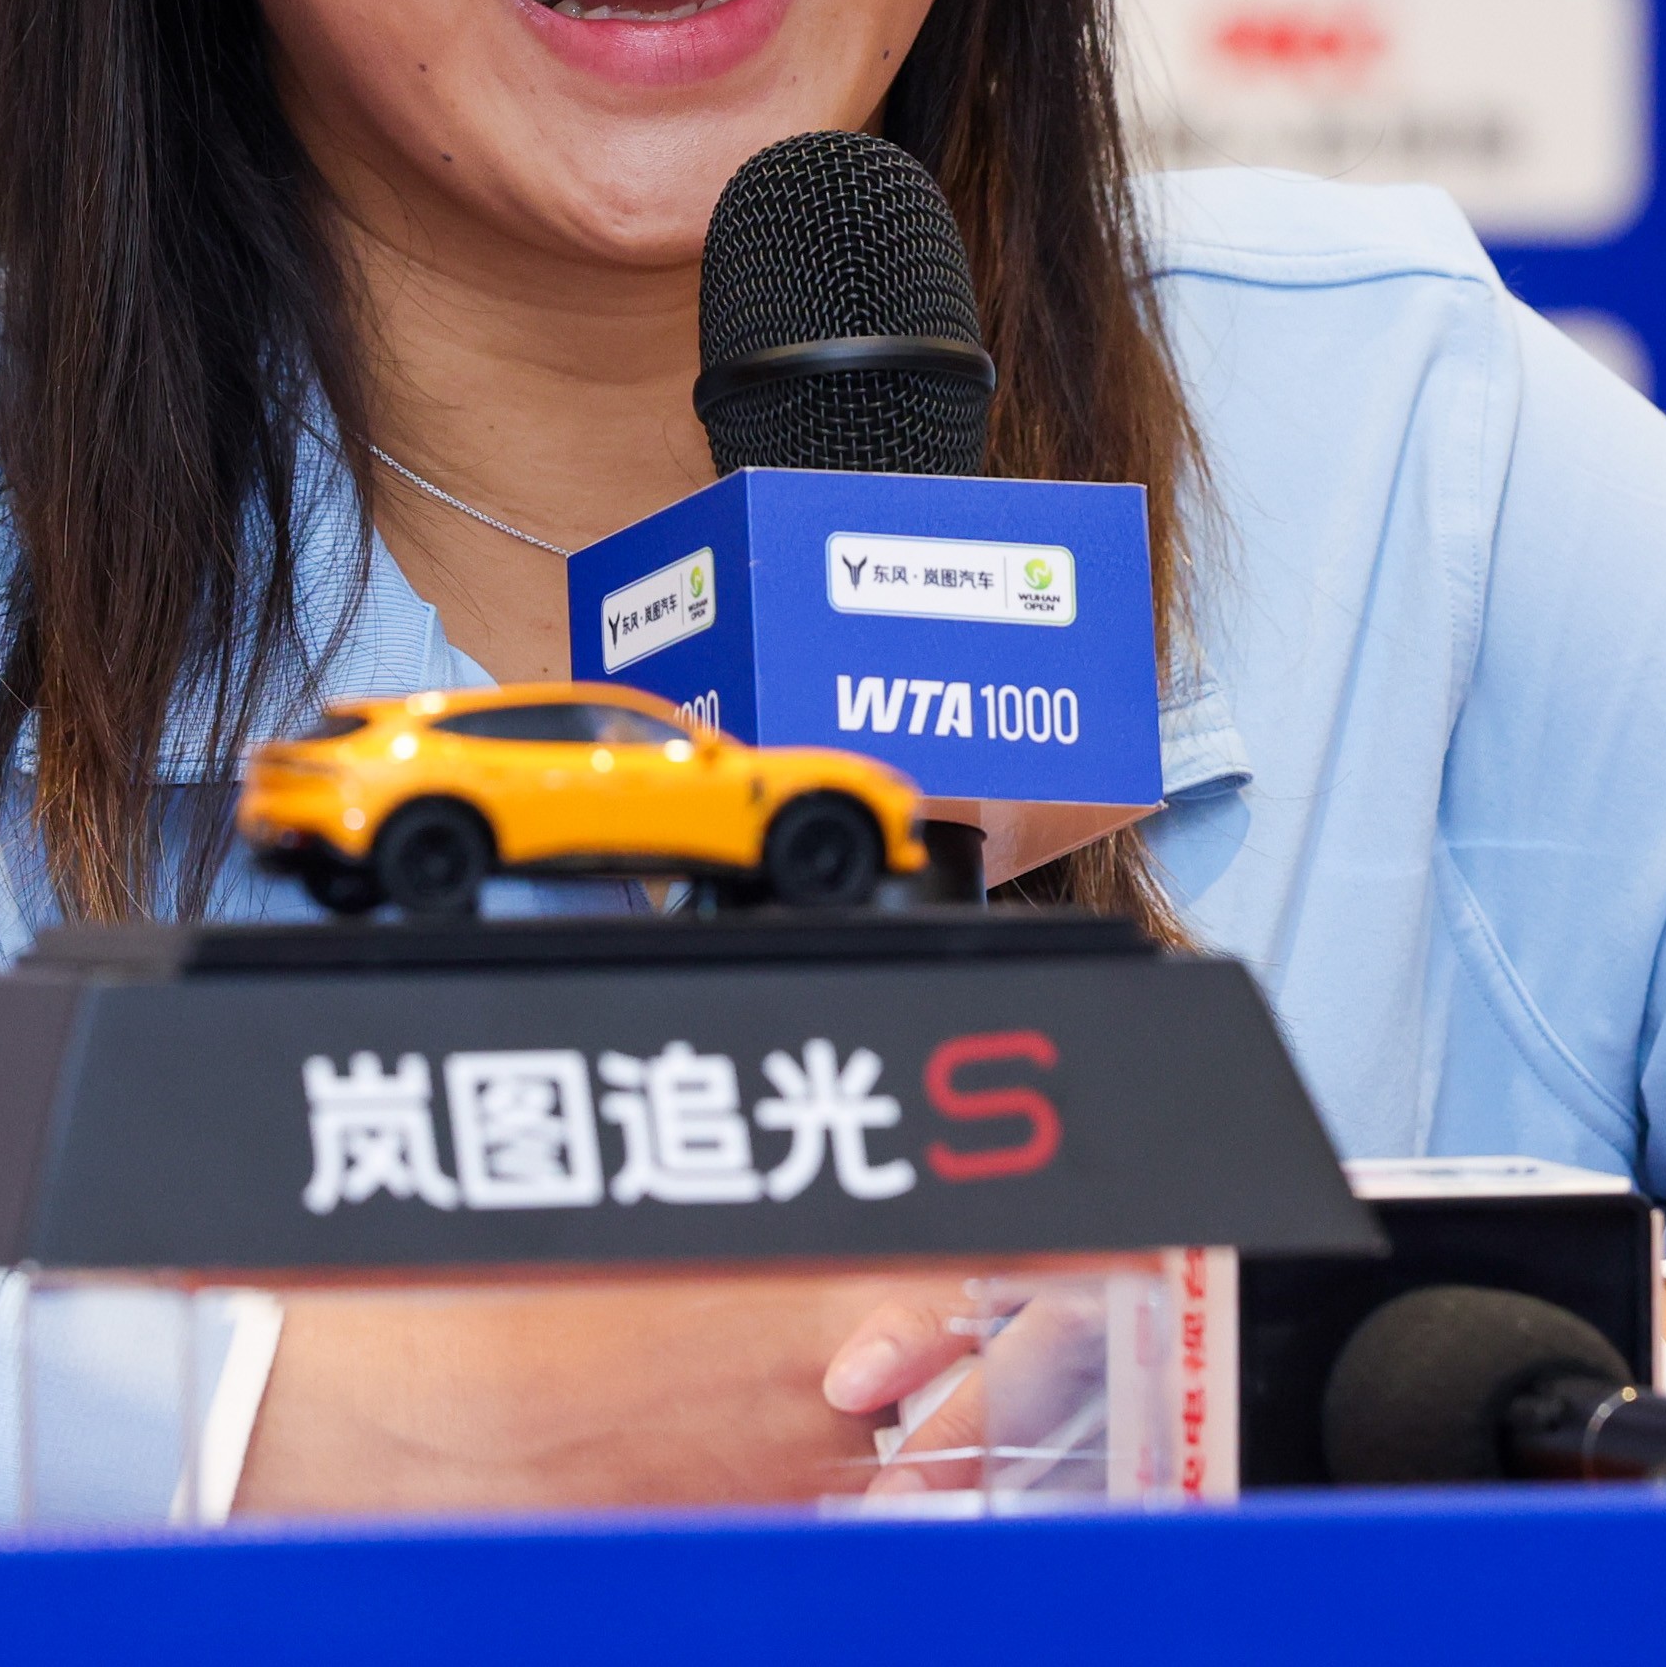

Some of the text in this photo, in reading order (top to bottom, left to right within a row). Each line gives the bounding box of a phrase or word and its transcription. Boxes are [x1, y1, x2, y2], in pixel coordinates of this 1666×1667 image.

[1018, 593, 1061, 603] WUHAN
[1024, 602, 1055, 612] OPEN
[836, 674, 1079, 745] WTA 1000
